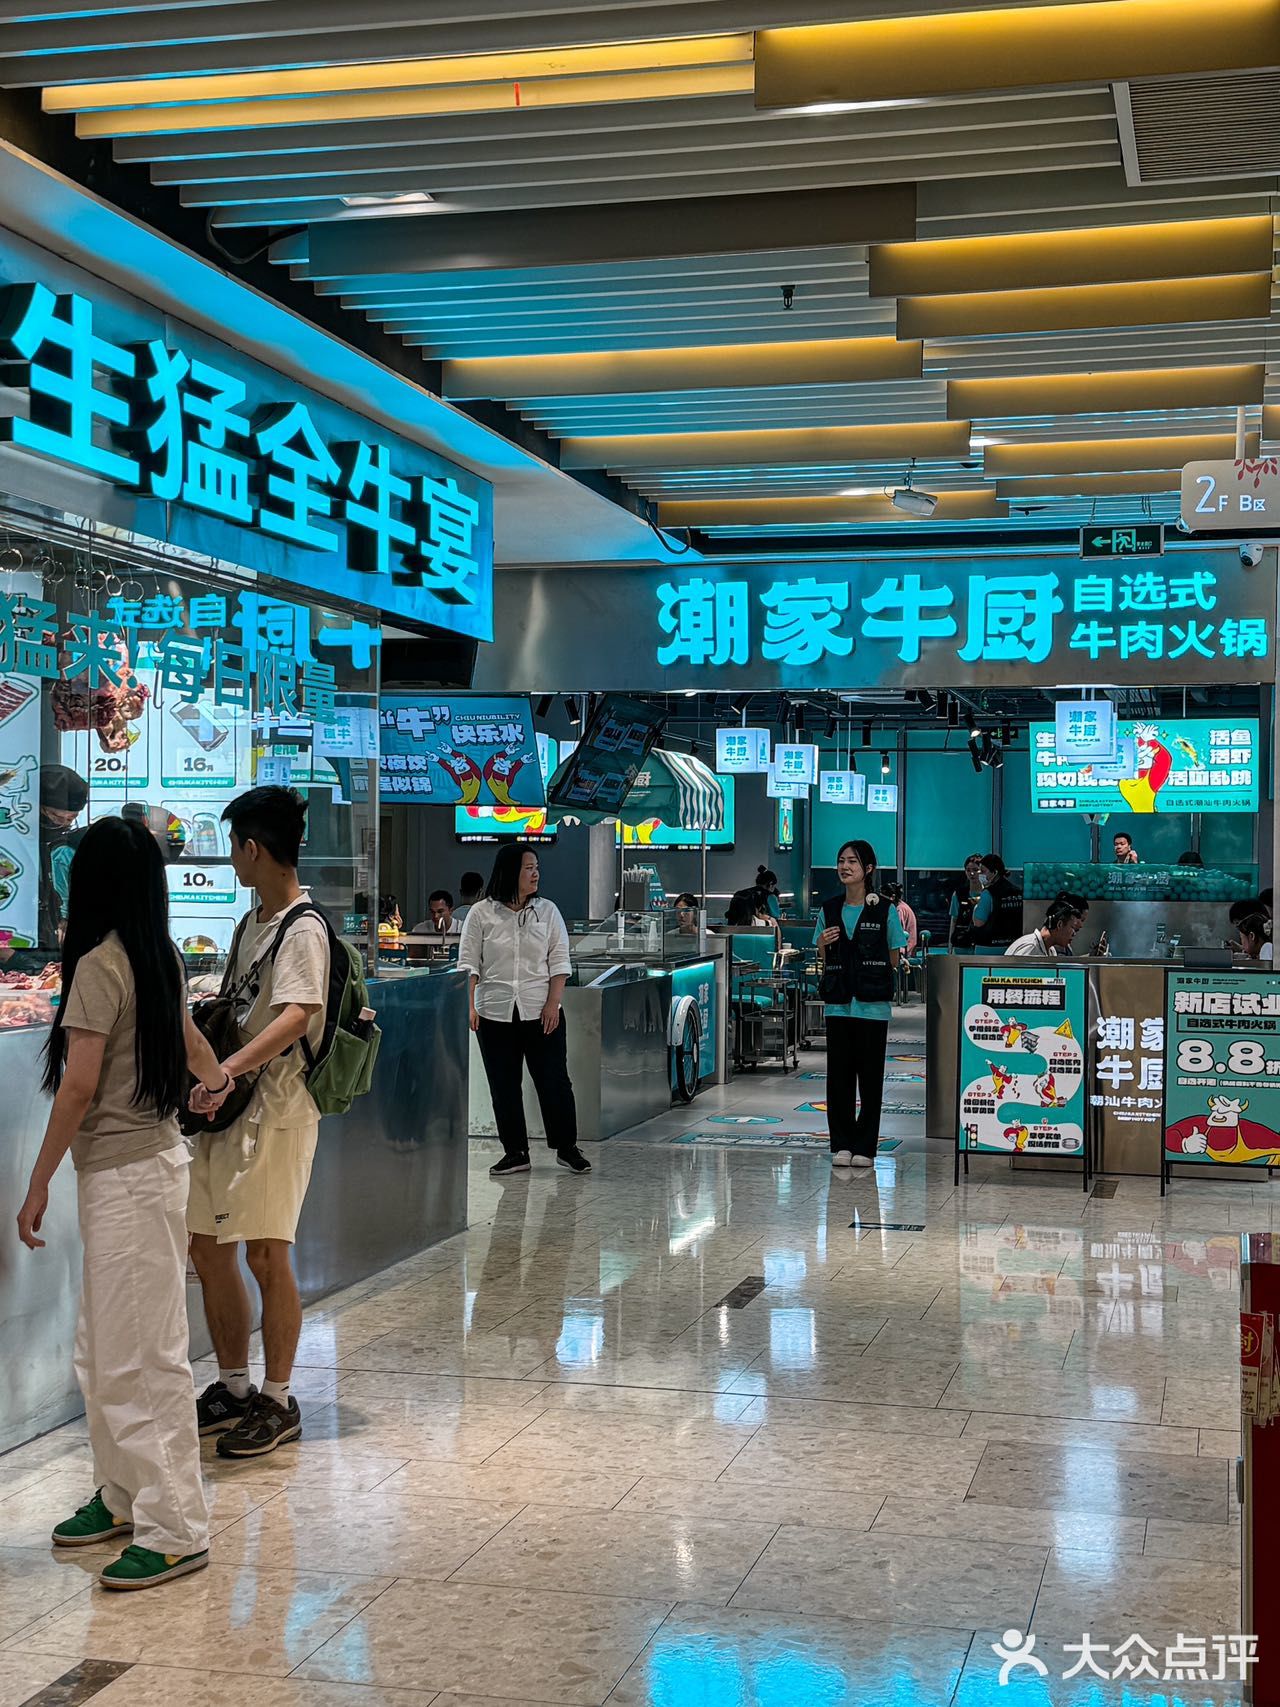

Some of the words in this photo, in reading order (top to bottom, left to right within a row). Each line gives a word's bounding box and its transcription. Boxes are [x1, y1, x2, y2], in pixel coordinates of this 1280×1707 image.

[11, 282, 480, 606] 生猛全牛宴
[1195, 475, 1229, 513] 2F
[1073, 571, 1218, 612] 自选式
[656, 574, 1064, 666] 潮家牛厨
[1069, 617, 1268, 660] 牛肉火锅
[1069, 710, 1097, 722] 潮家
[451, 723, 524, 744] 快乐水
[1069, 724, 1097, 737] 牛厨
[1210, 729, 1252, 746] 活鱼
[1210, 749, 1252, 764] 活虾
[987, 988, 1060, 1005] 用餐流程
[1187, 1018, 1276, 1031] 自选式牛肉火锅
